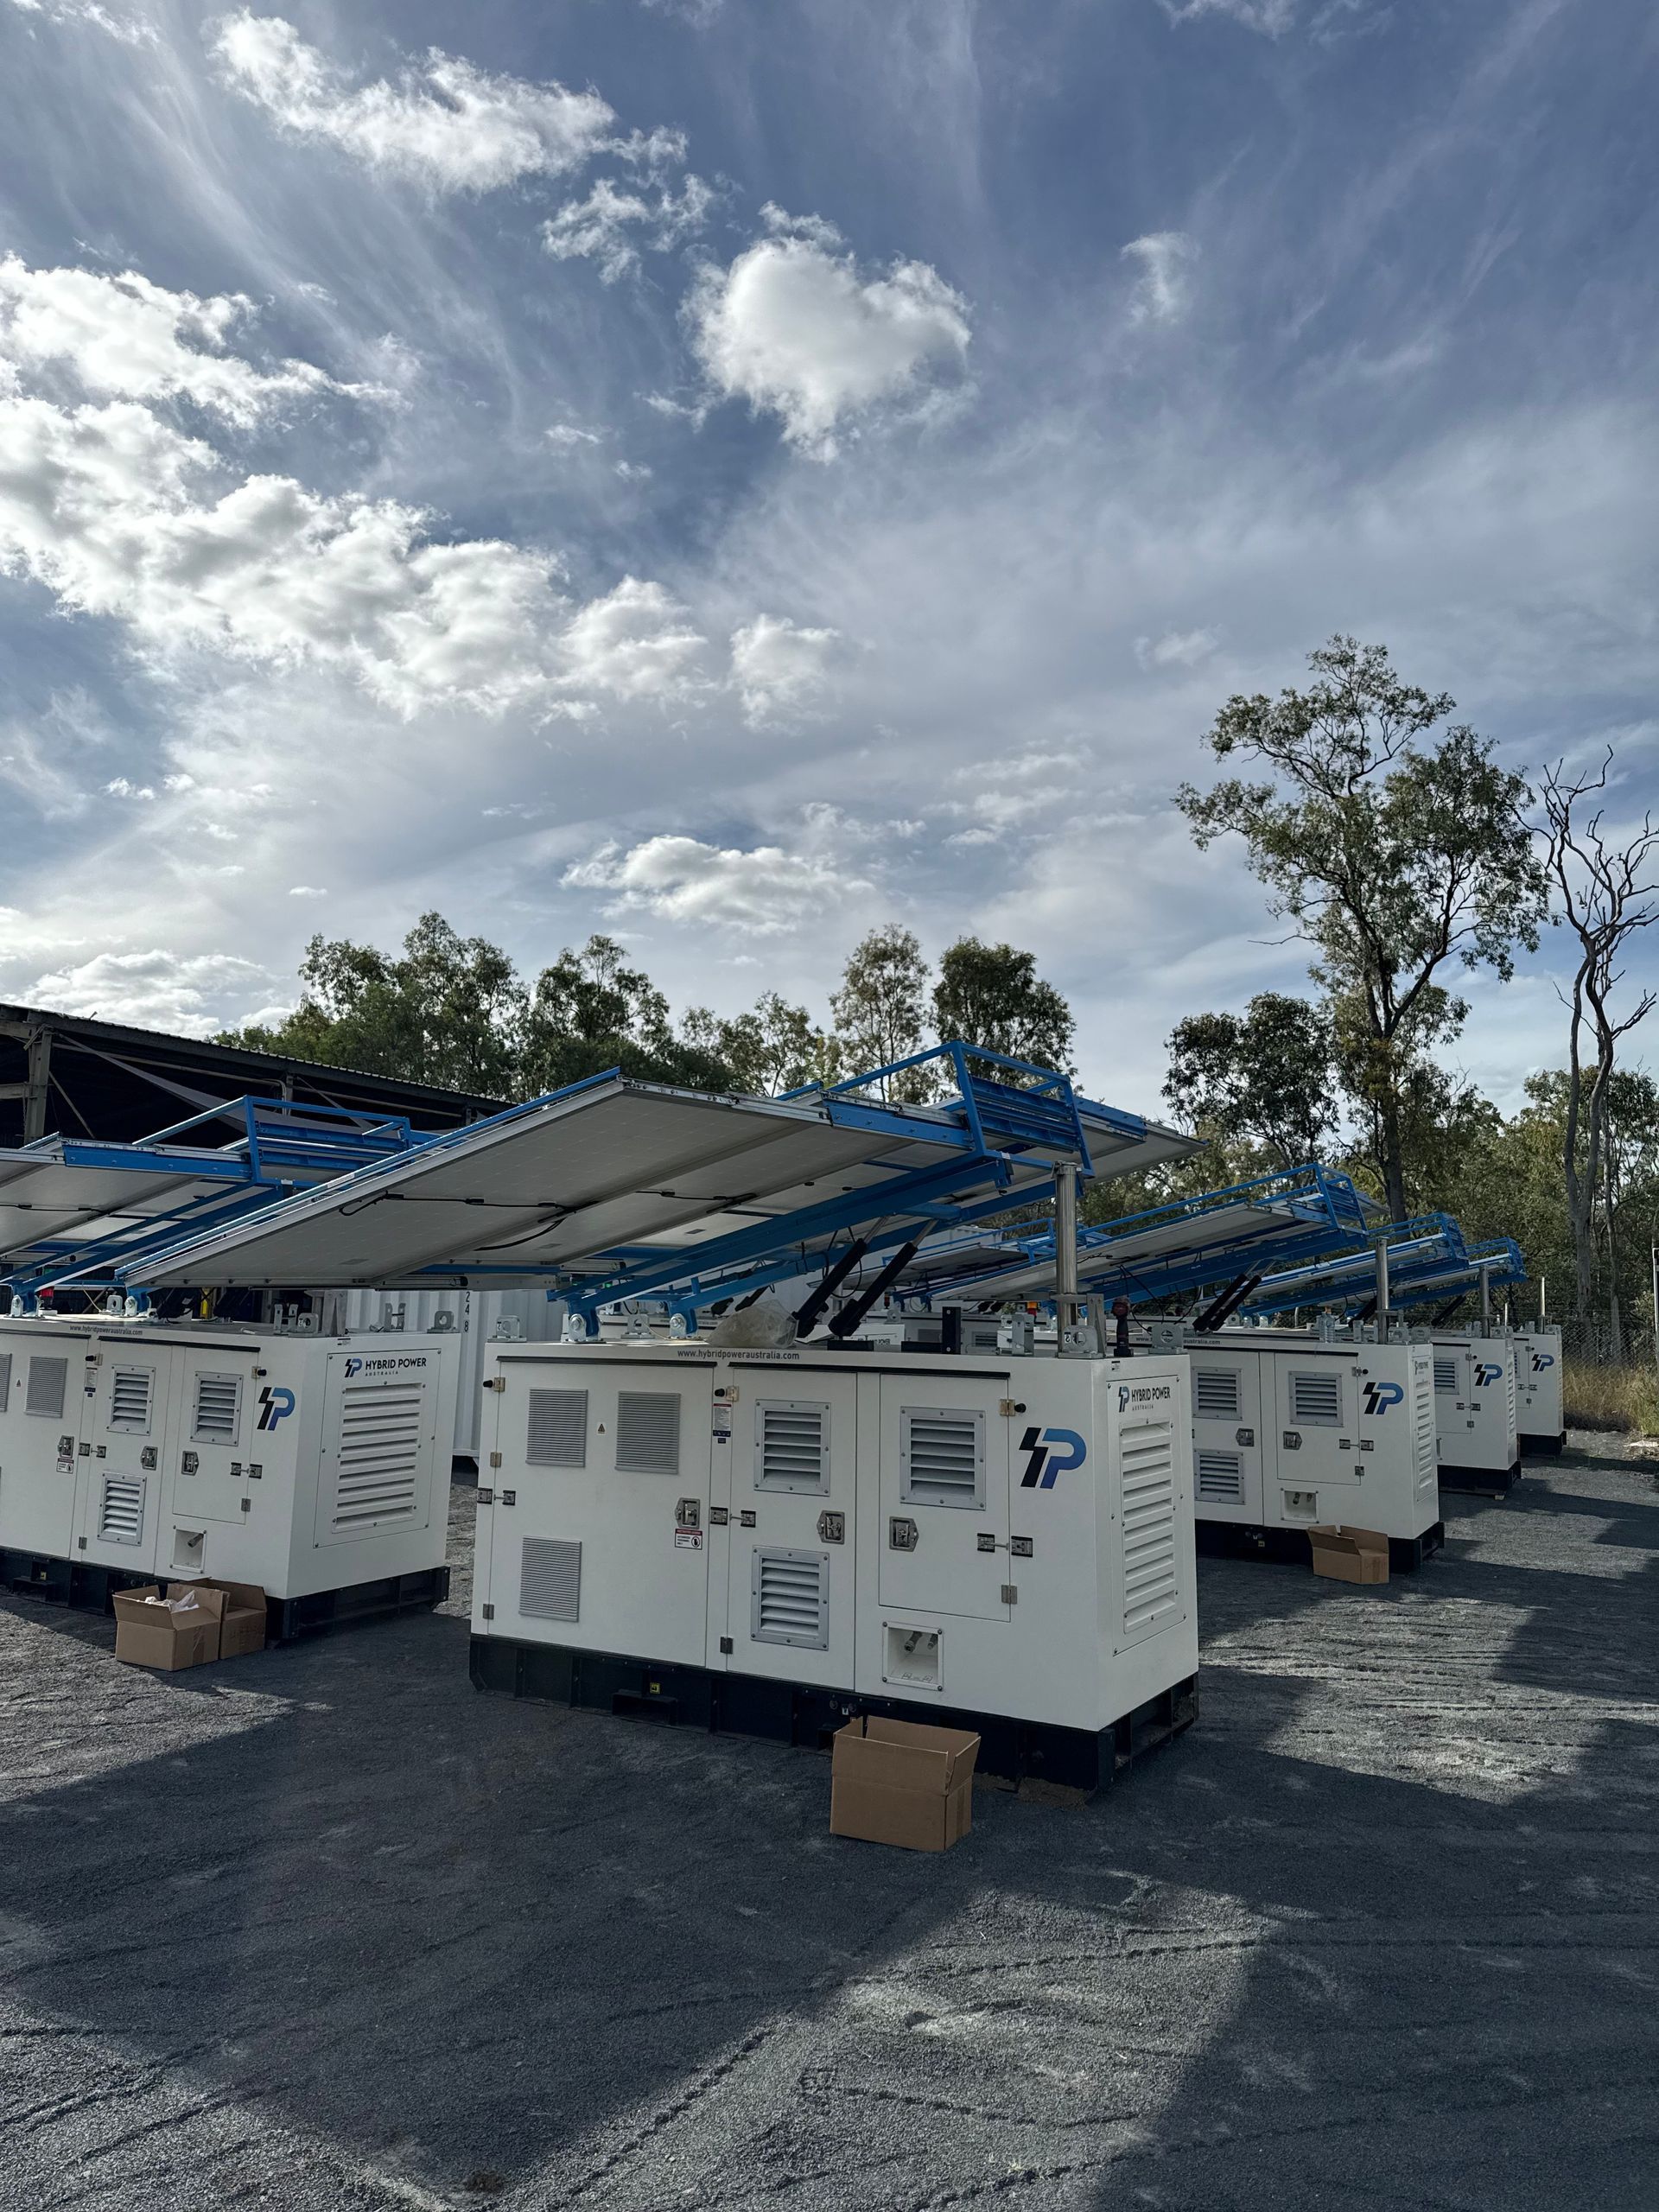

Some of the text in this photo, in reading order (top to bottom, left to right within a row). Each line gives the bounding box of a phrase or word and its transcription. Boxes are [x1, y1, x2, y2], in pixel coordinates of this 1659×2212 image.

[677, 1349, 800, 1360] www.hybridpoweraustralia.com
[365, 1357, 427, 1370] HYBRID POWER
[1131, 1386, 1171, 1402] HYBRID POWER
